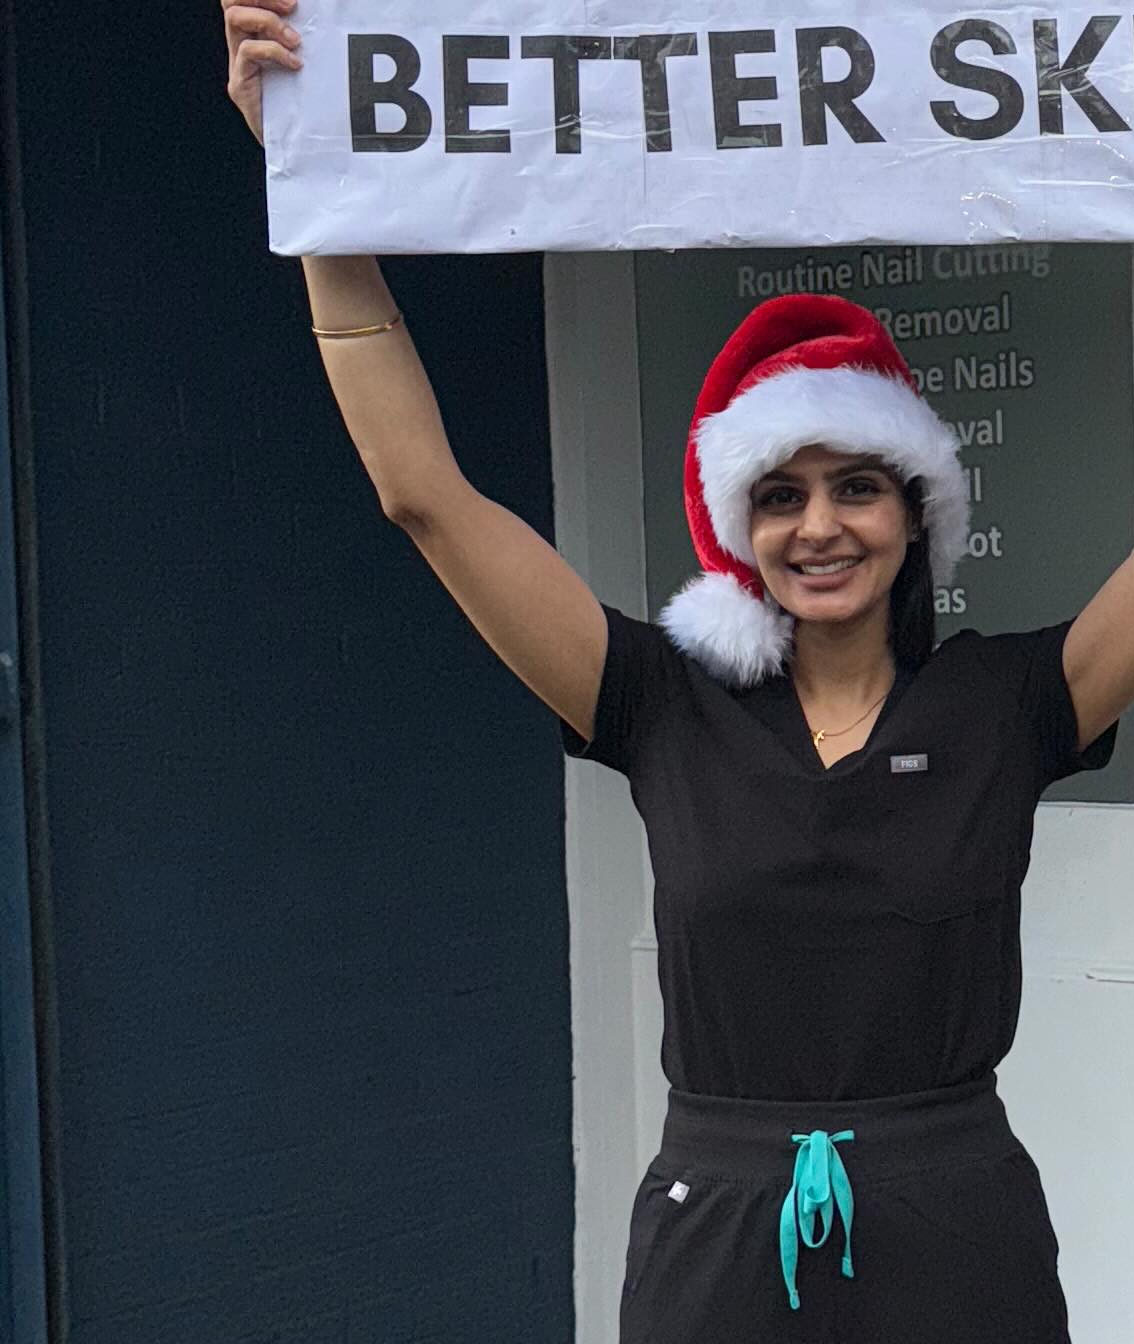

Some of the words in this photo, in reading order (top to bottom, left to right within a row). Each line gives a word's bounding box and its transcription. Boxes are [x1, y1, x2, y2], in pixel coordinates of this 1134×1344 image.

[347, 24, 886, 156] BETTER
[738, 258, 851, 297] Routine
[862, 248, 923, 287] Nail
[932, 246, 1049, 278] Cutting
[954, 352, 1034, 390] Nails
